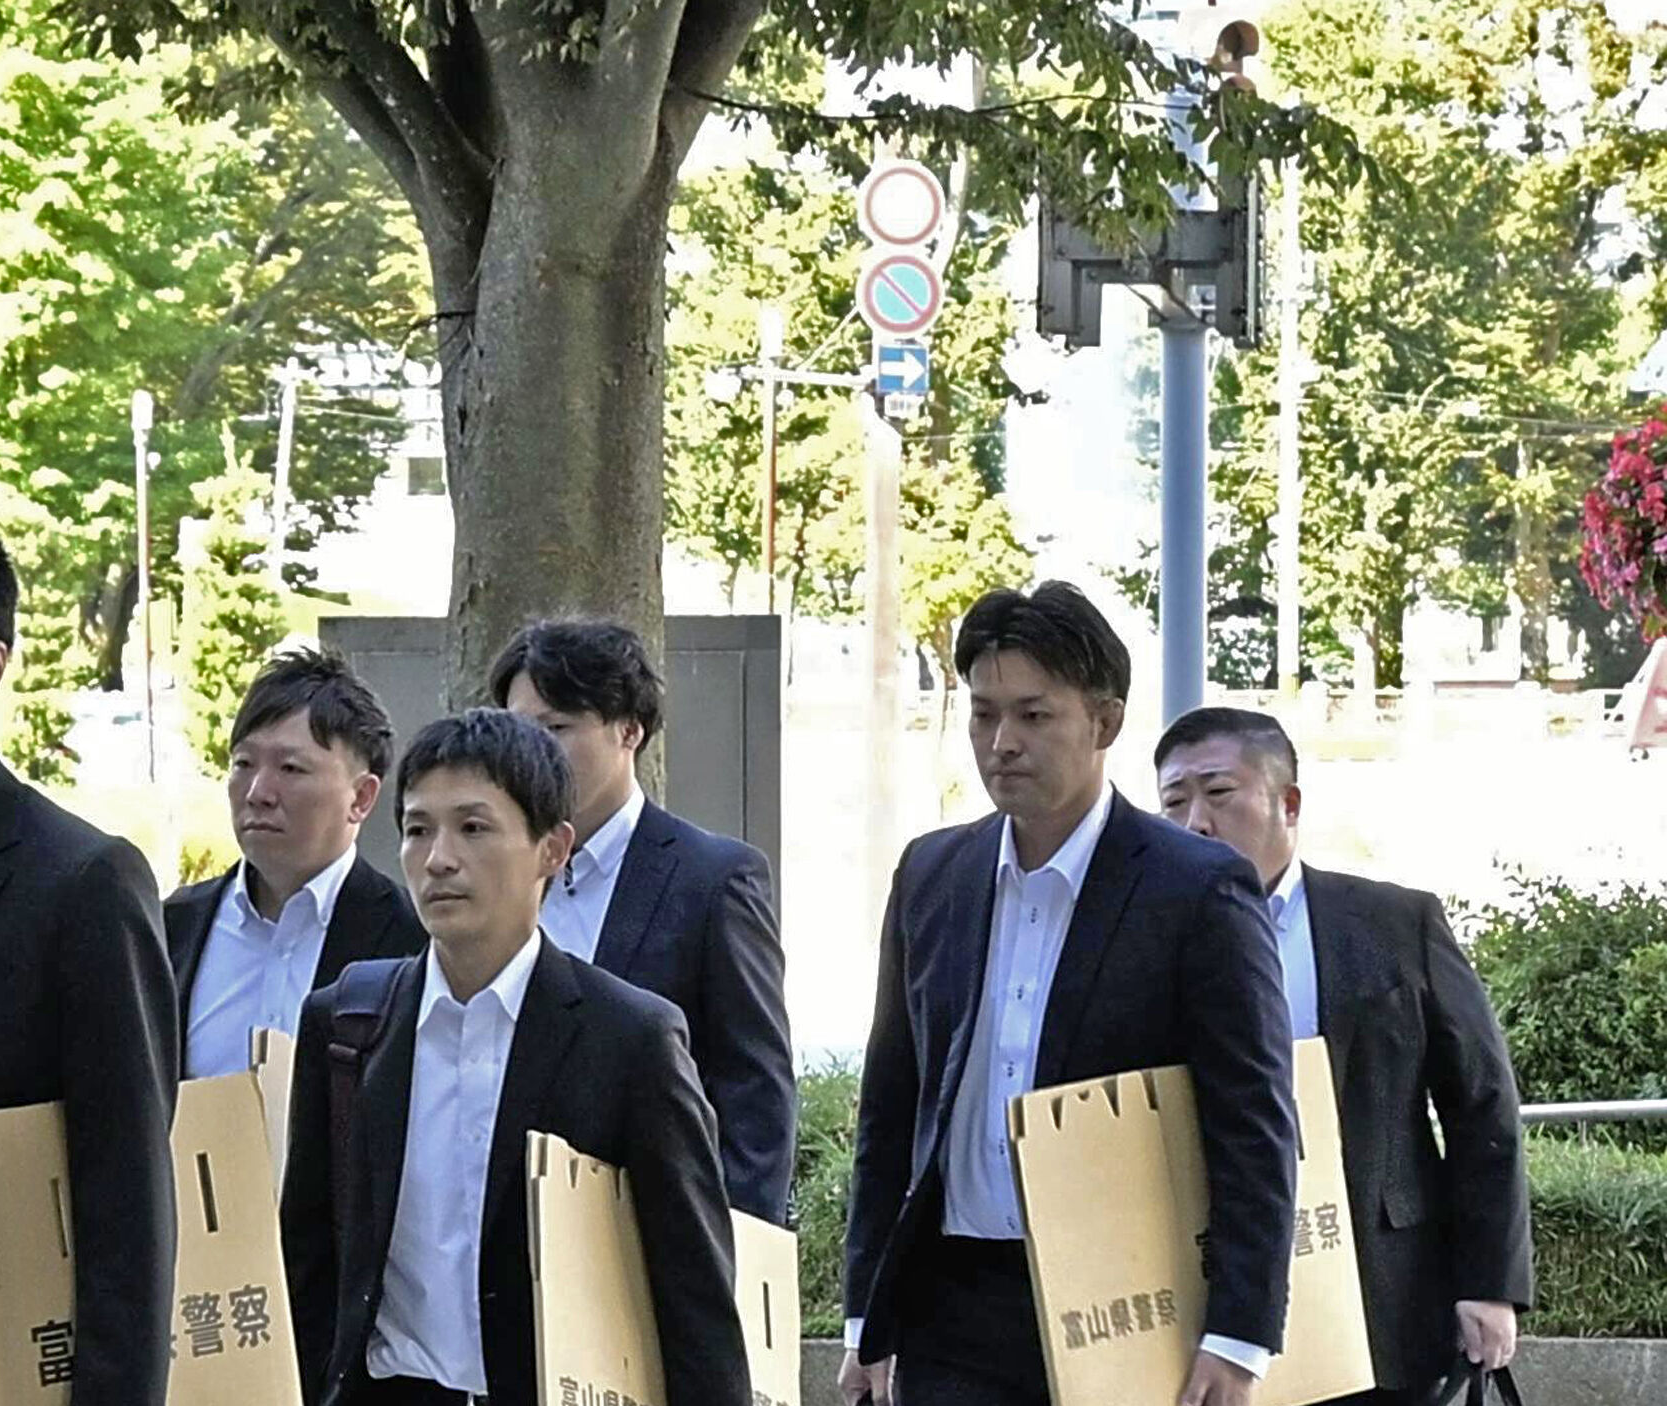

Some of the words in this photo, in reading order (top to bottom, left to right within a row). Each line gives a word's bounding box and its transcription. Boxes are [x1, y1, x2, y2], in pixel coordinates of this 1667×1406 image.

[1060, 1288, 1178, 1349] 富山県警察
